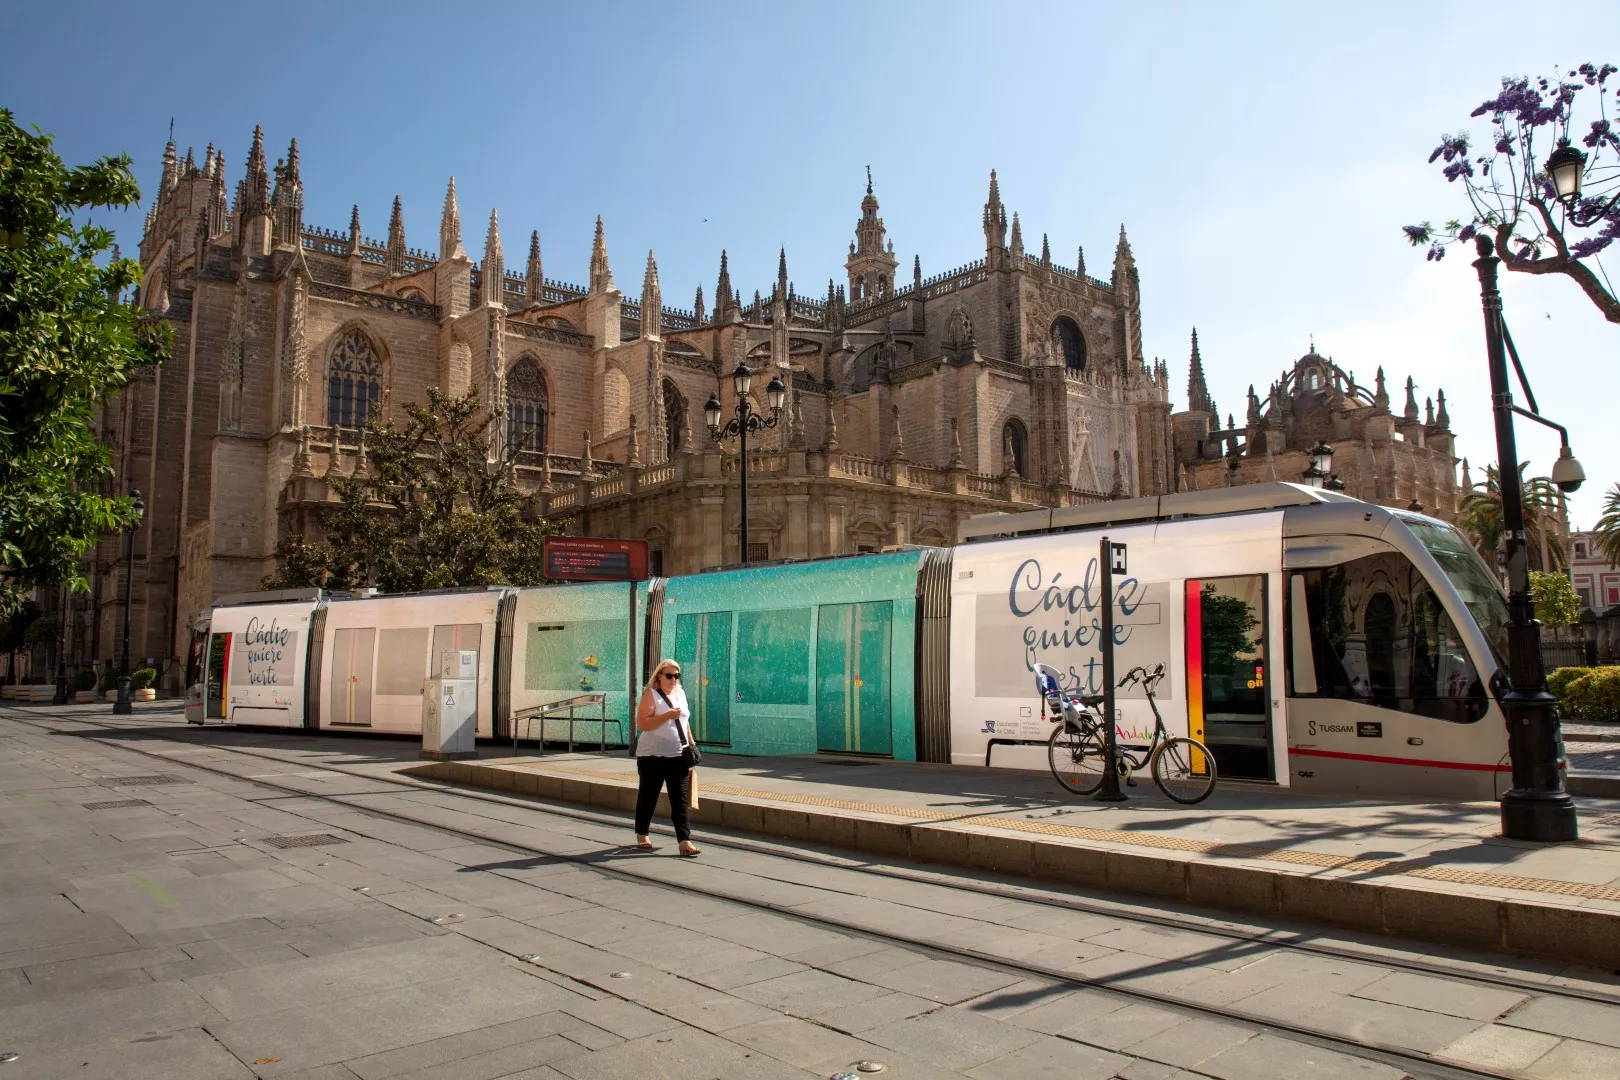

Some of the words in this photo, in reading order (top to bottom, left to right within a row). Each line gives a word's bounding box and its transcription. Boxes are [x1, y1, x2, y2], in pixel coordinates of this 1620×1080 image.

[1113, 548, 1126, 570] H
[1009, 557, 1148, 617] Cádz
[247, 647, 284, 674] quiere
[249, 666, 278, 685] verte
[1319, 724, 1354, 733] TUSSAM
